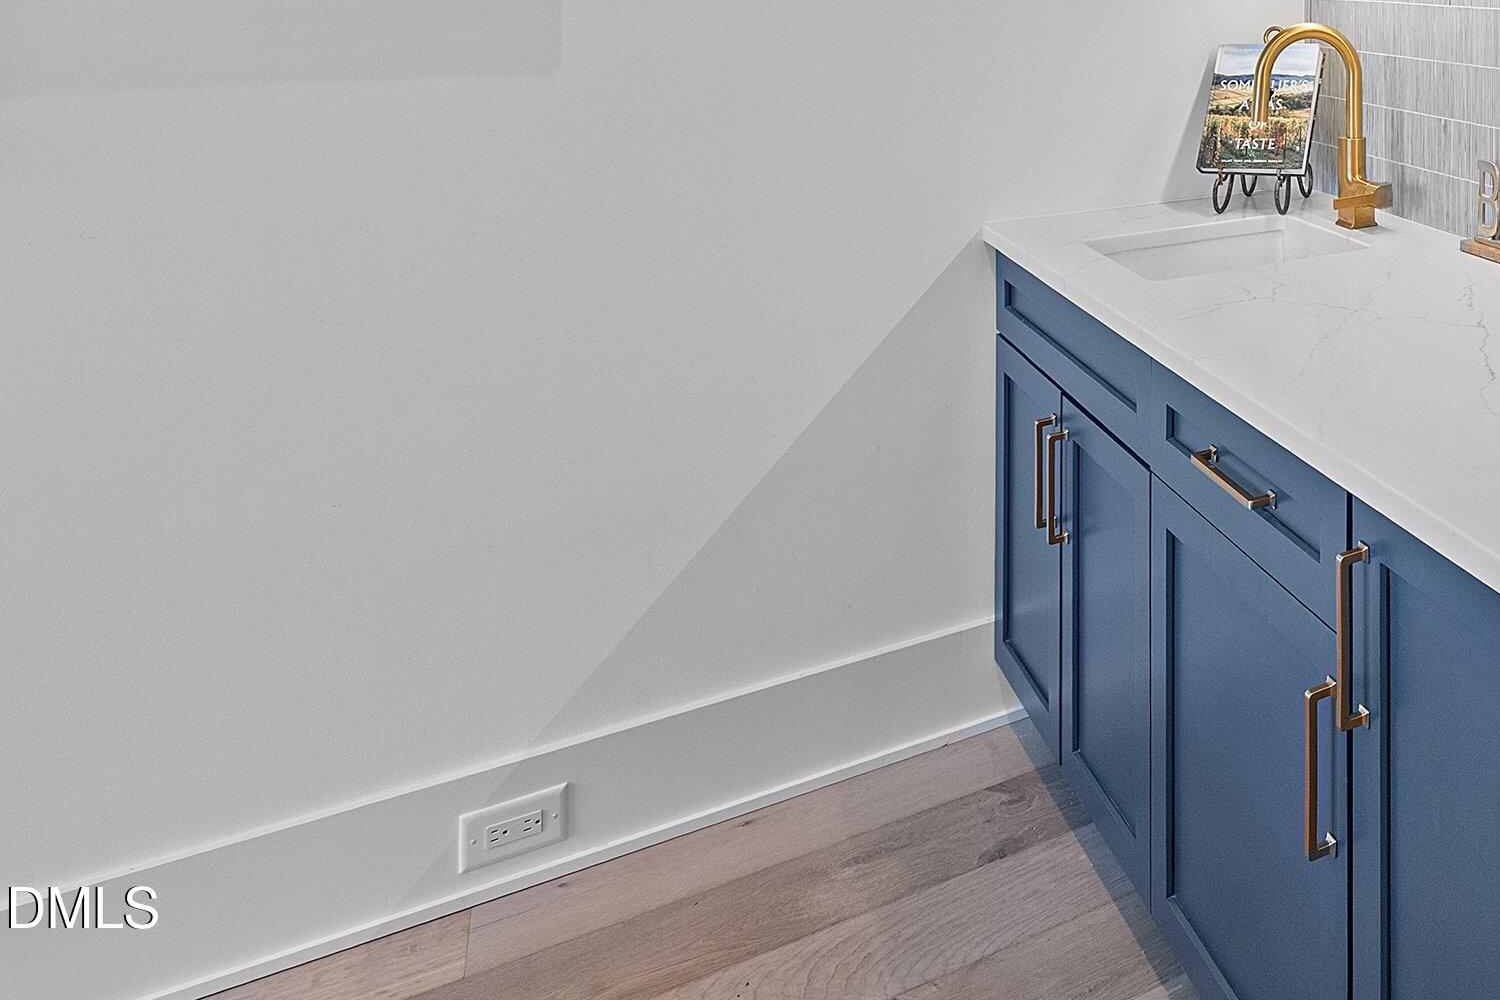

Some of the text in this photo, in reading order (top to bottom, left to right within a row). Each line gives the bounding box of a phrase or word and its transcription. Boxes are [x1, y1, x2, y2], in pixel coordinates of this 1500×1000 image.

[1220, 79, 1309, 92] SOMLIER'S
[1239, 98, 1283, 110] AAS
[1234, 138, 1277, 150] TASTE
